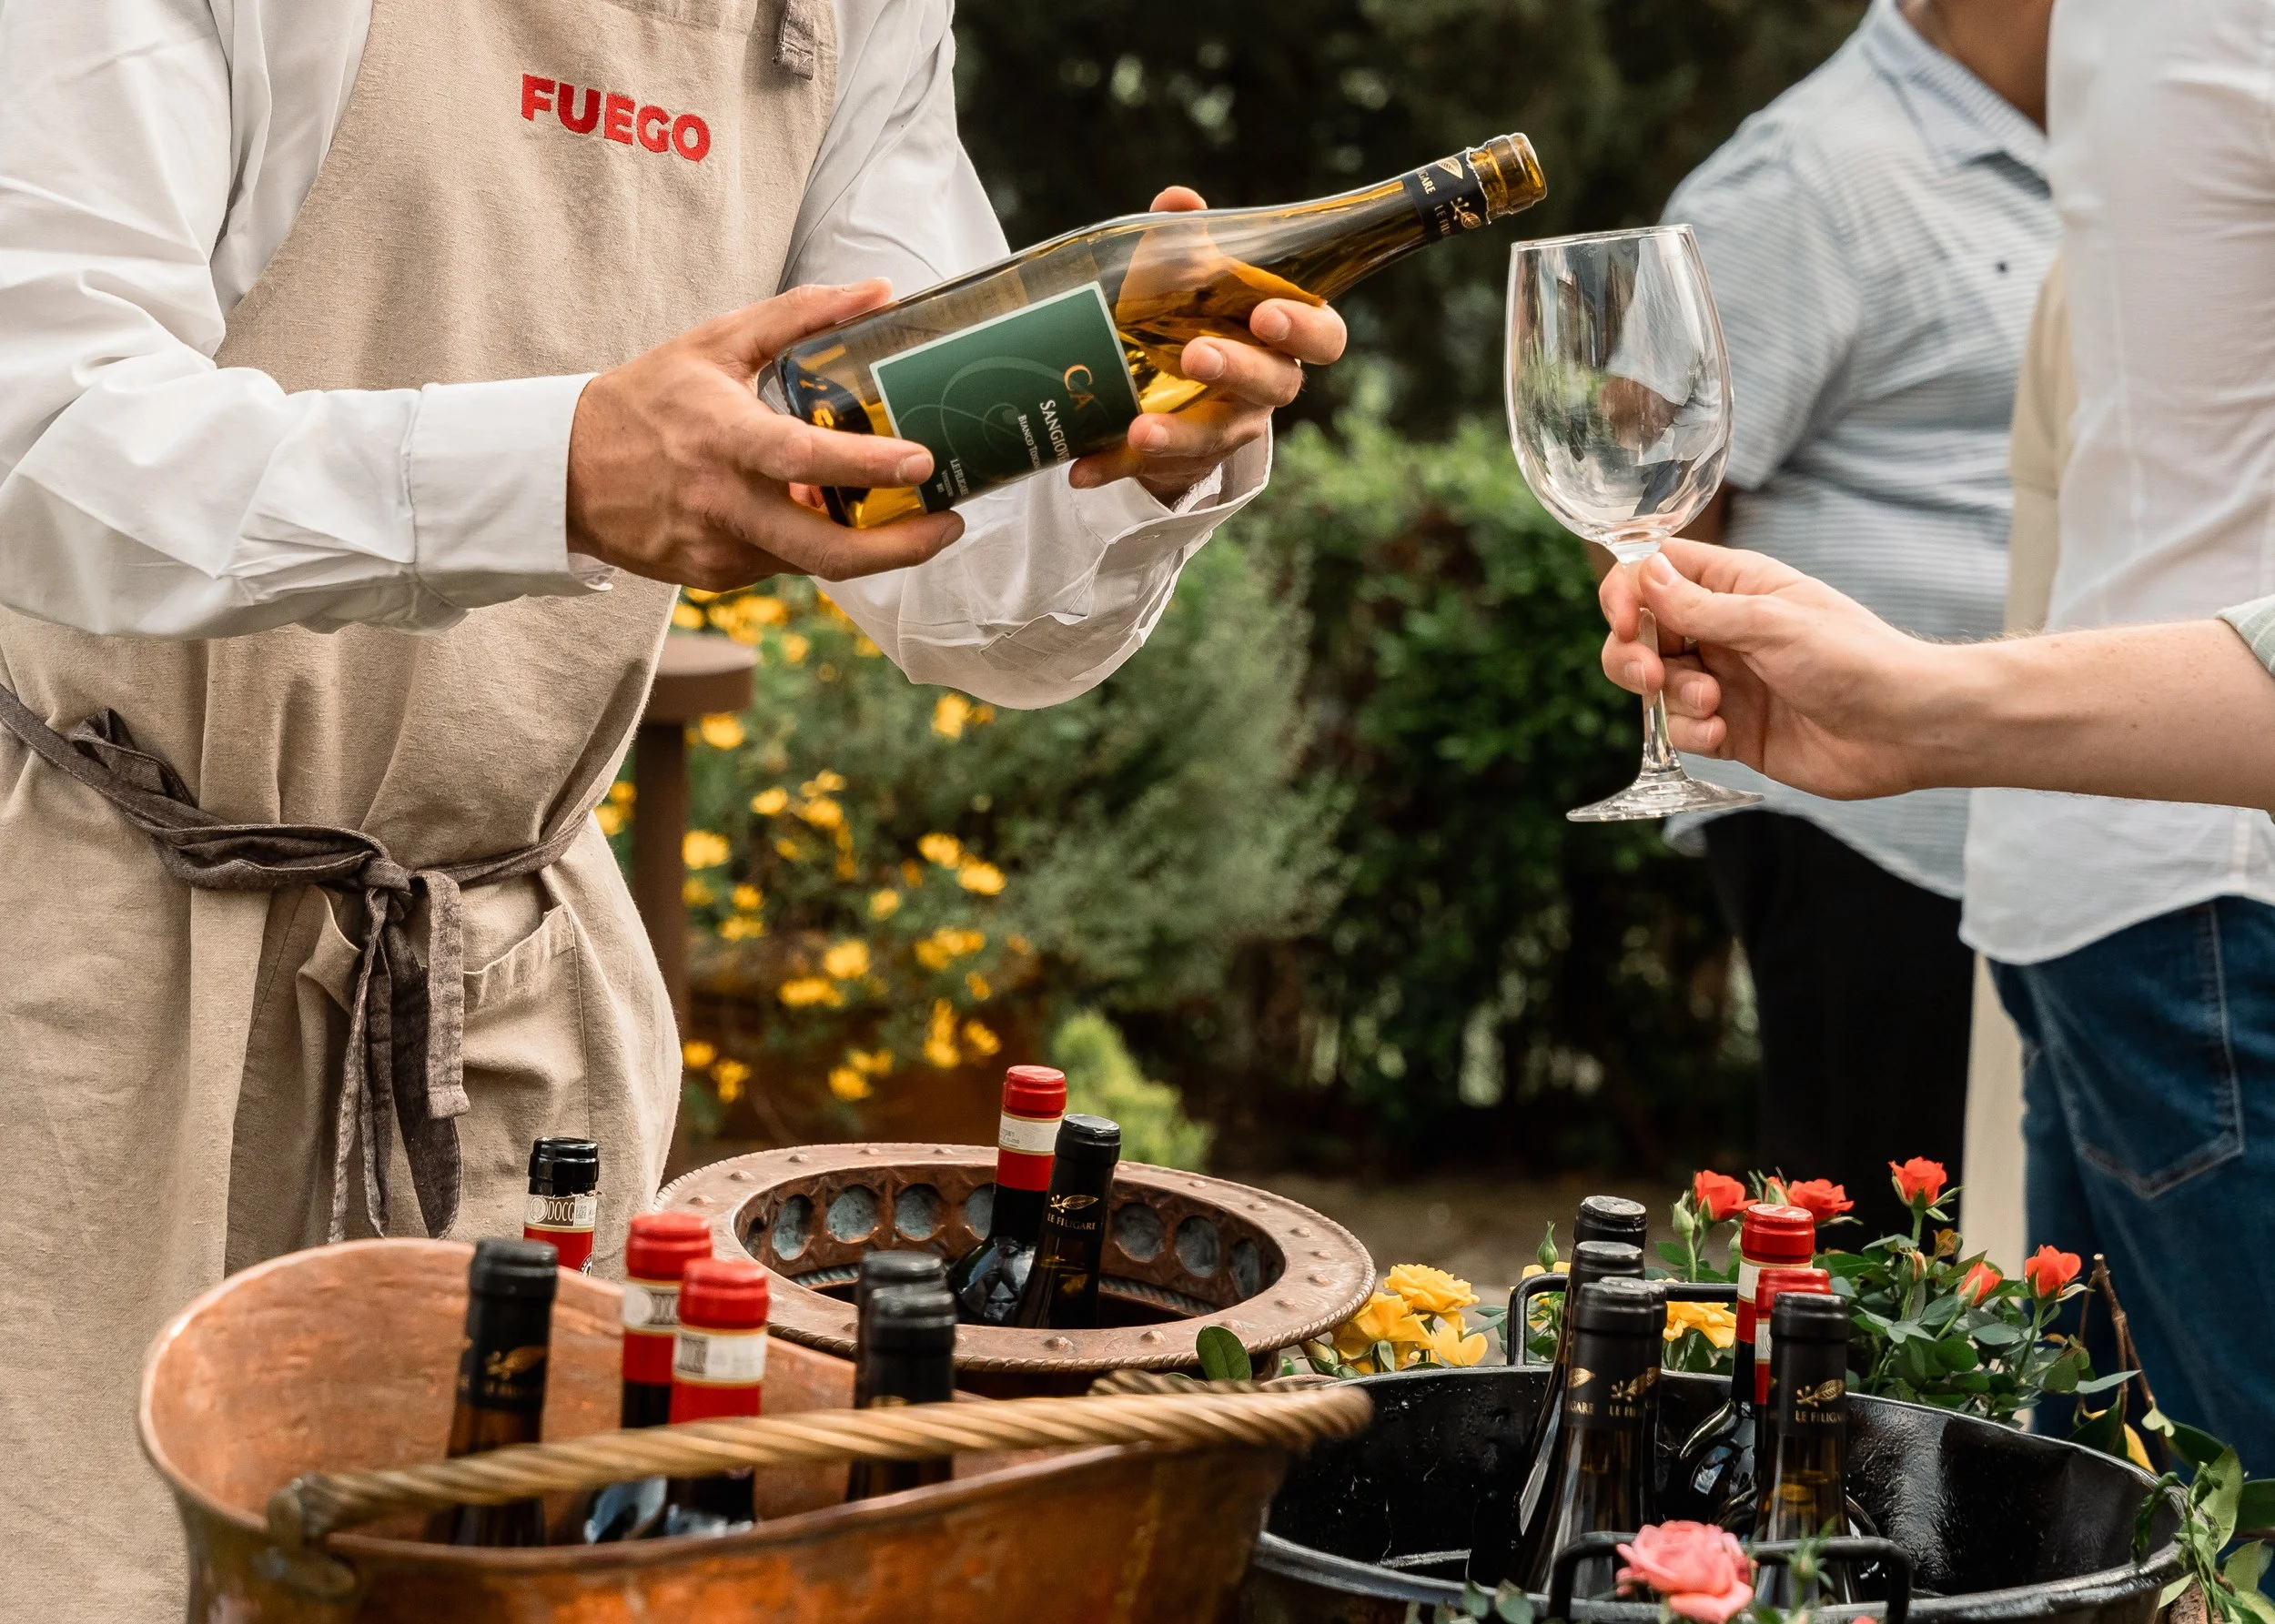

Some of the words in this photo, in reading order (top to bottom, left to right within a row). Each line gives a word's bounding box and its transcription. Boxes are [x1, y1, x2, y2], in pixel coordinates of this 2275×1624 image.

[521, 73, 712, 163] FUEGO
[1434, 205, 1447, 218] LE
[1439, 218, 1451, 236] FIL
[1017, 414, 1035, 447] BIANCO
[1039, 399, 1070, 465] SANGIOVE
[548, 1200, 575, 1222] DOCG
[1046, 1213, 1056, 1224] LE
[1057, 1216, 1096, 1230] FILIGARE
[1795, 1409, 1807, 1424] LE
